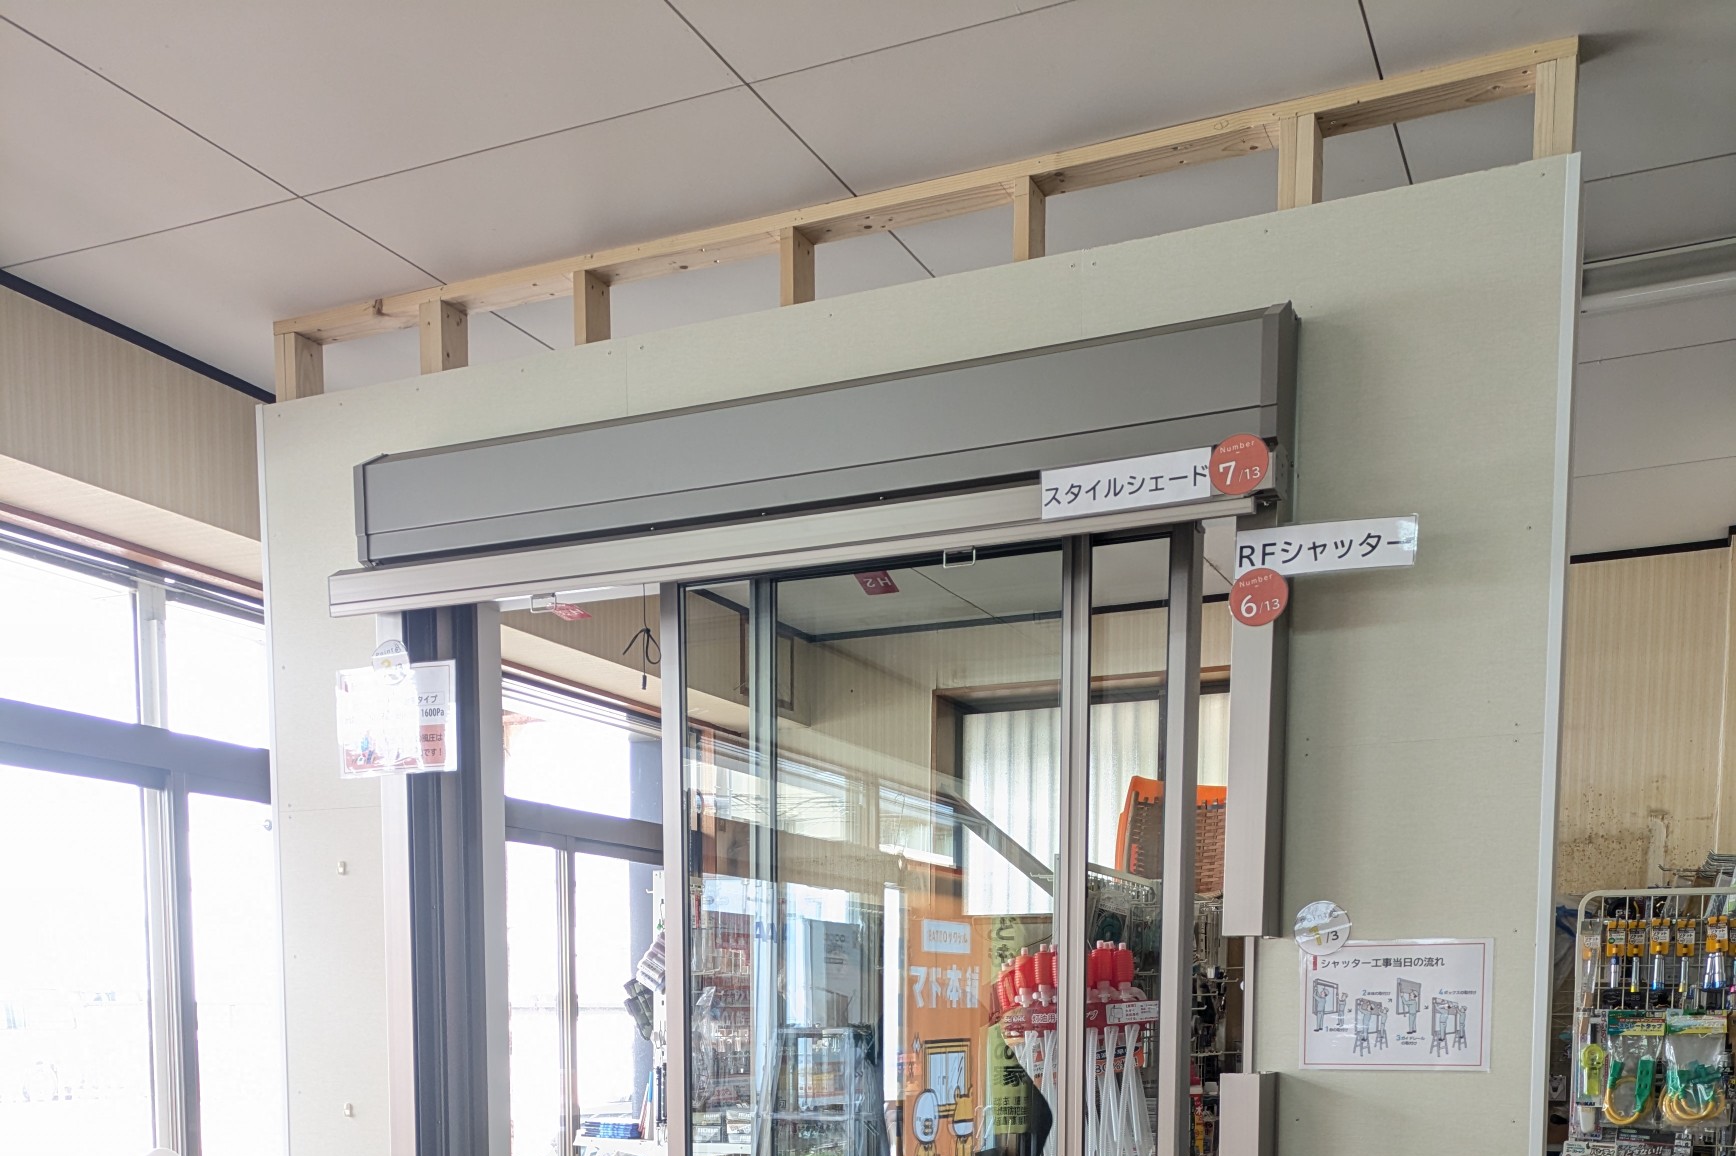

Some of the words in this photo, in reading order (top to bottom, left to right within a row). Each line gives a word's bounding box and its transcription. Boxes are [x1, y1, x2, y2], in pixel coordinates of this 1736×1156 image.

[1219, 439, 1256, 454] Number
[1043, 464, 1210, 507] スタイルシェード
[1238, 532, 1415, 568] RFシャッター
[1239, 573, 1274, 588] Number
[421, 708, 445, 717] 1600Pa
[1321, 956, 1446, 968] シャッター工事当日の流れ
